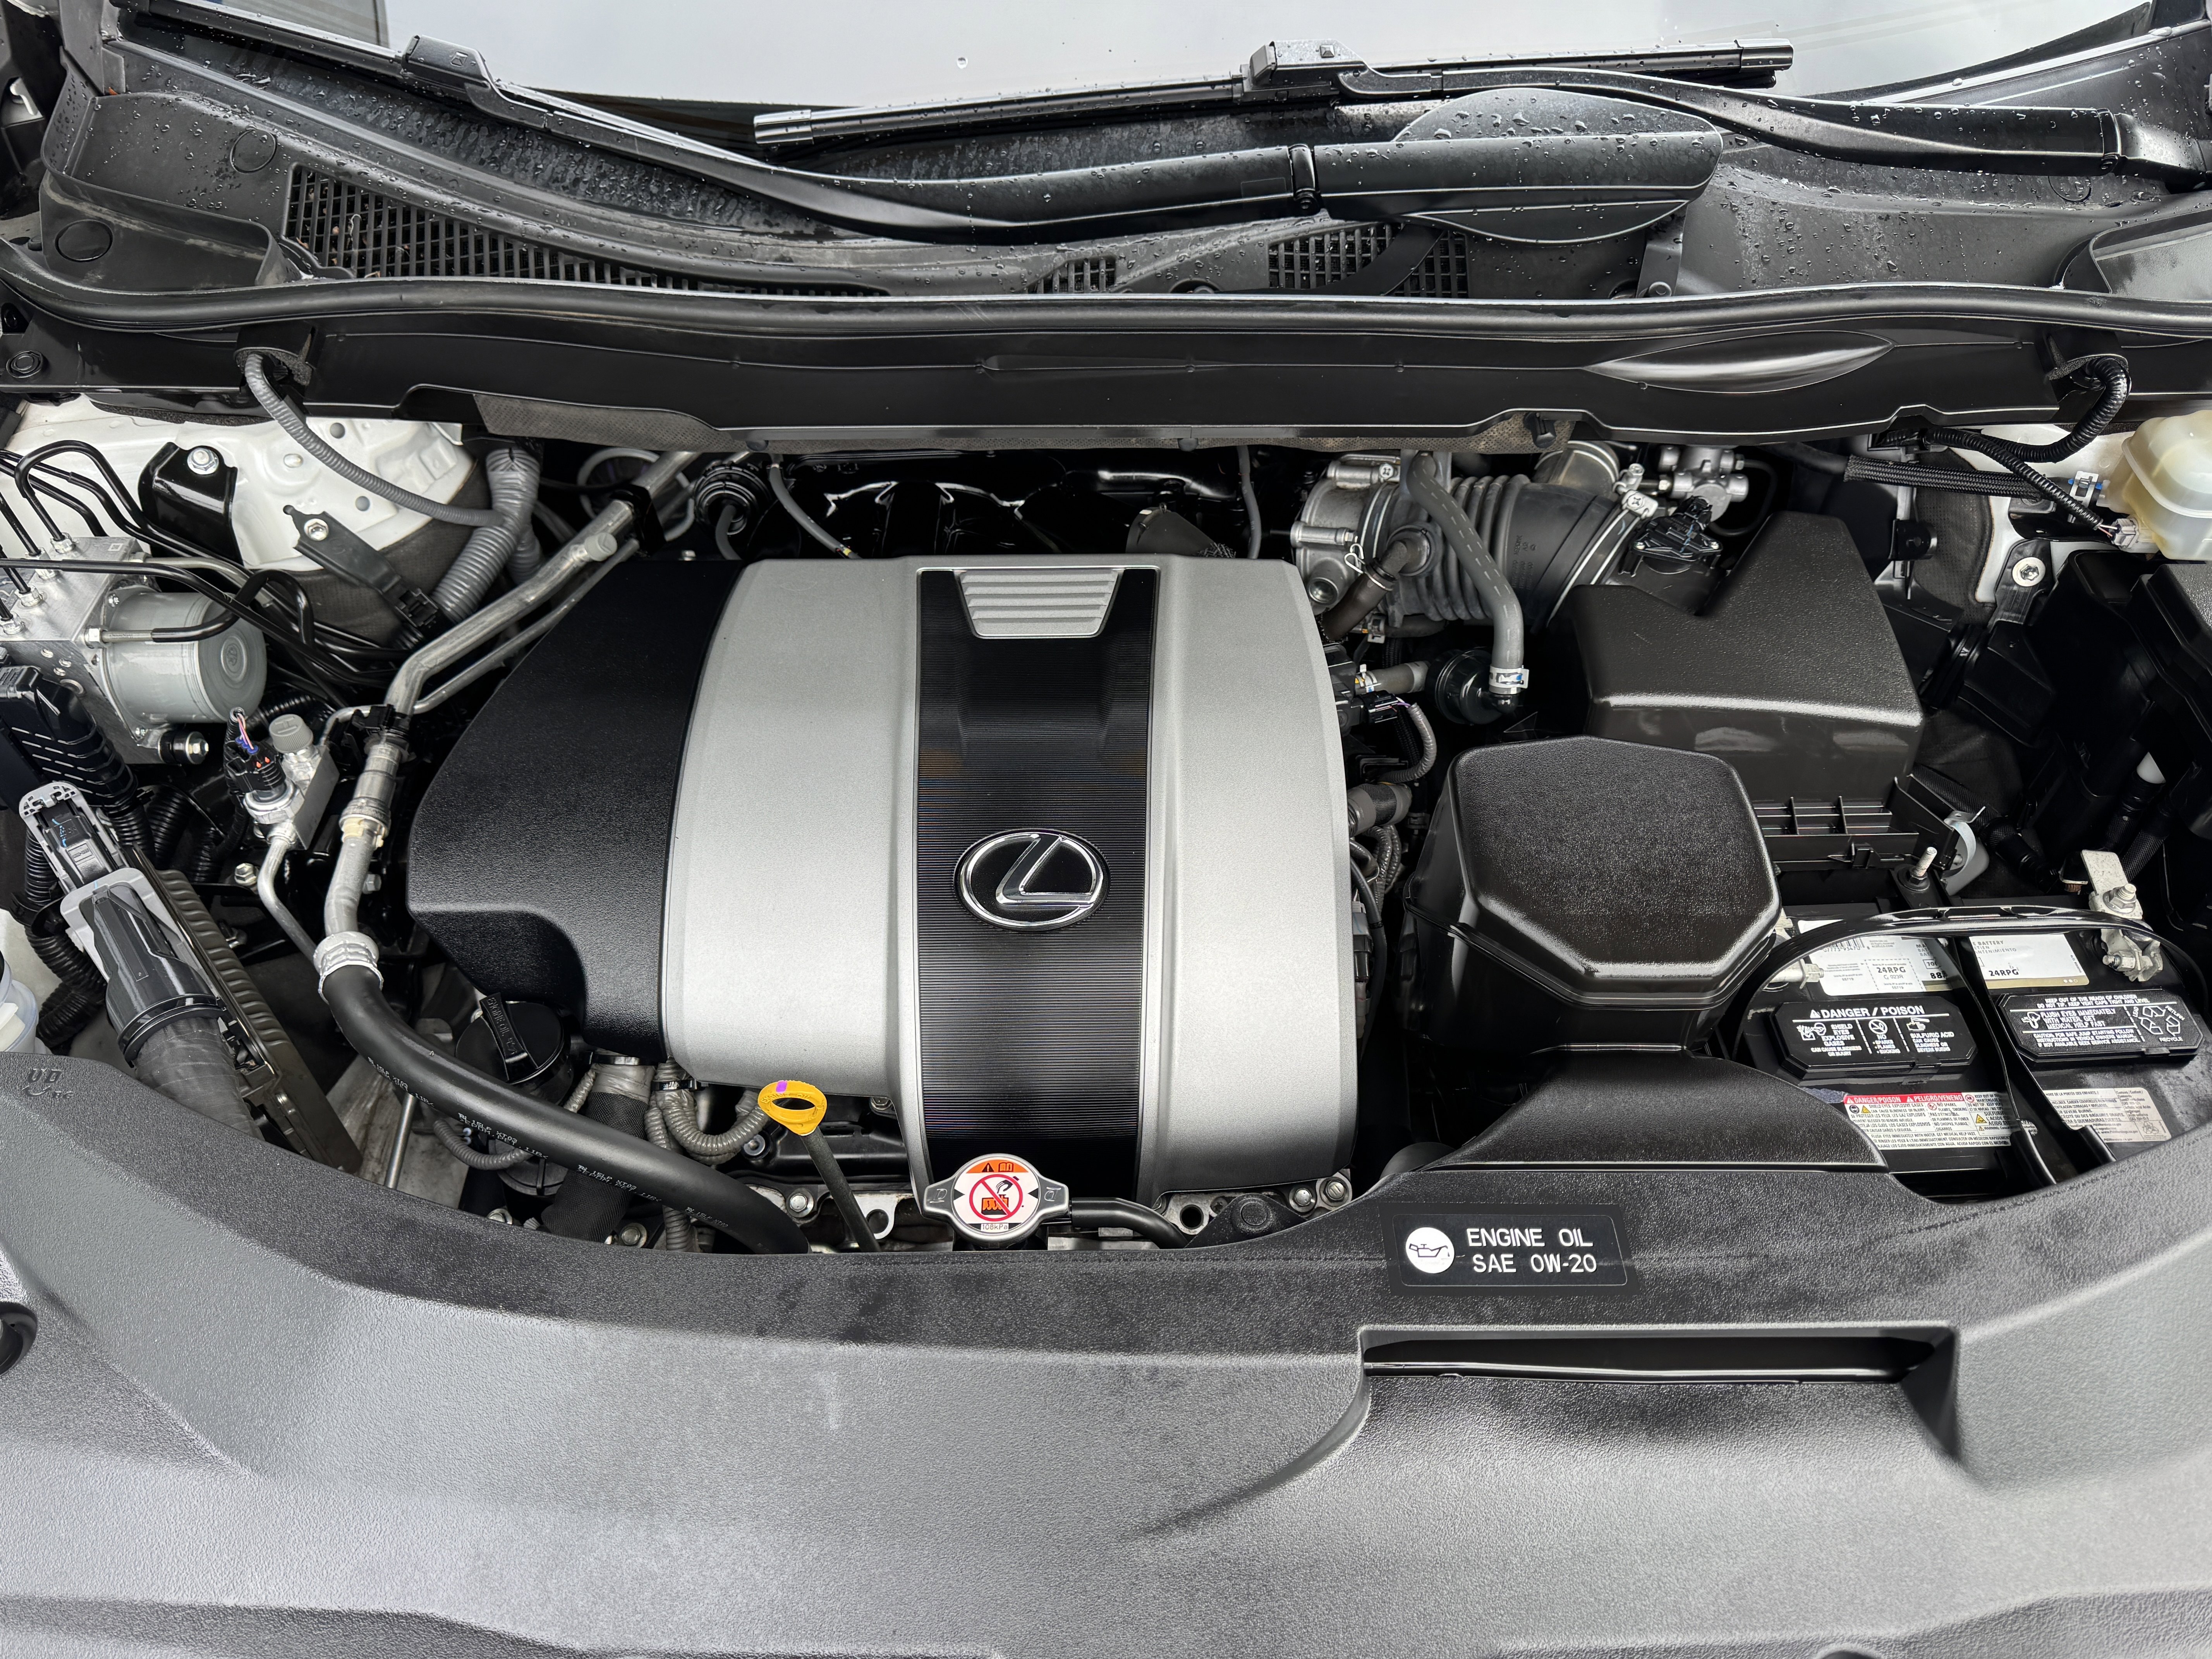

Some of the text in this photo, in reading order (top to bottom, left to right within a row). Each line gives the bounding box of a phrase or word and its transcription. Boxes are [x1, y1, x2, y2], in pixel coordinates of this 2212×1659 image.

[488, 997, 505, 1022] ENGINE
[1820, 1005, 1925, 1018] DANGER / POISON
[2165, 1005, 2185, 1021] RETURN
[1467, 1228, 1594, 1247] ENGINE OIL
[1472, 1253, 1597, 1273] SAE 0W-20
